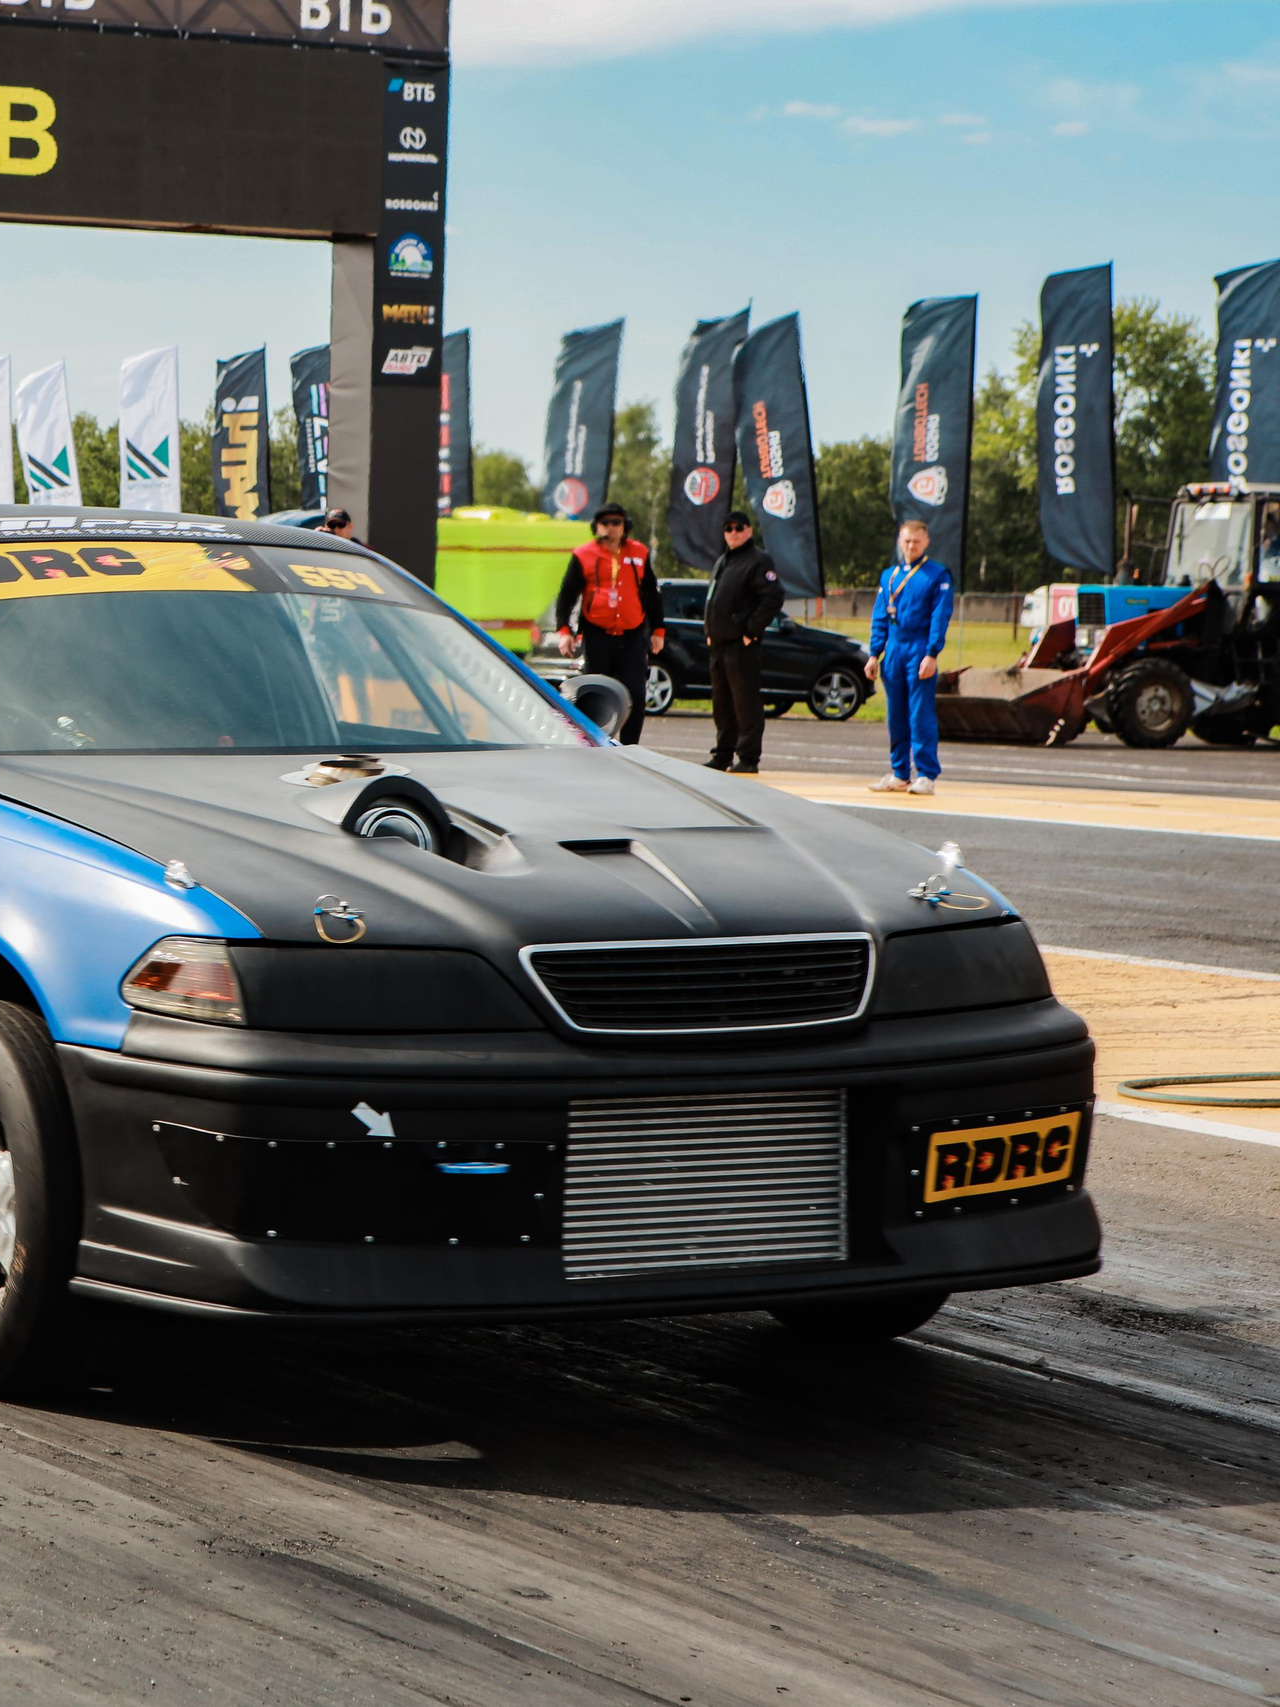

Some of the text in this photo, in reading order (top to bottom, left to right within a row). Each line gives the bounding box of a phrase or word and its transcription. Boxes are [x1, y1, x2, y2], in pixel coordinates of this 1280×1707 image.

[403, 81, 436, 102] ВТБ
[390, 352, 426, 364] АВТО
[81, 518, 227, 532] PSR
[287, 564, 387, 595] 554
[933, 1125, 1072, 1193] RDRC
